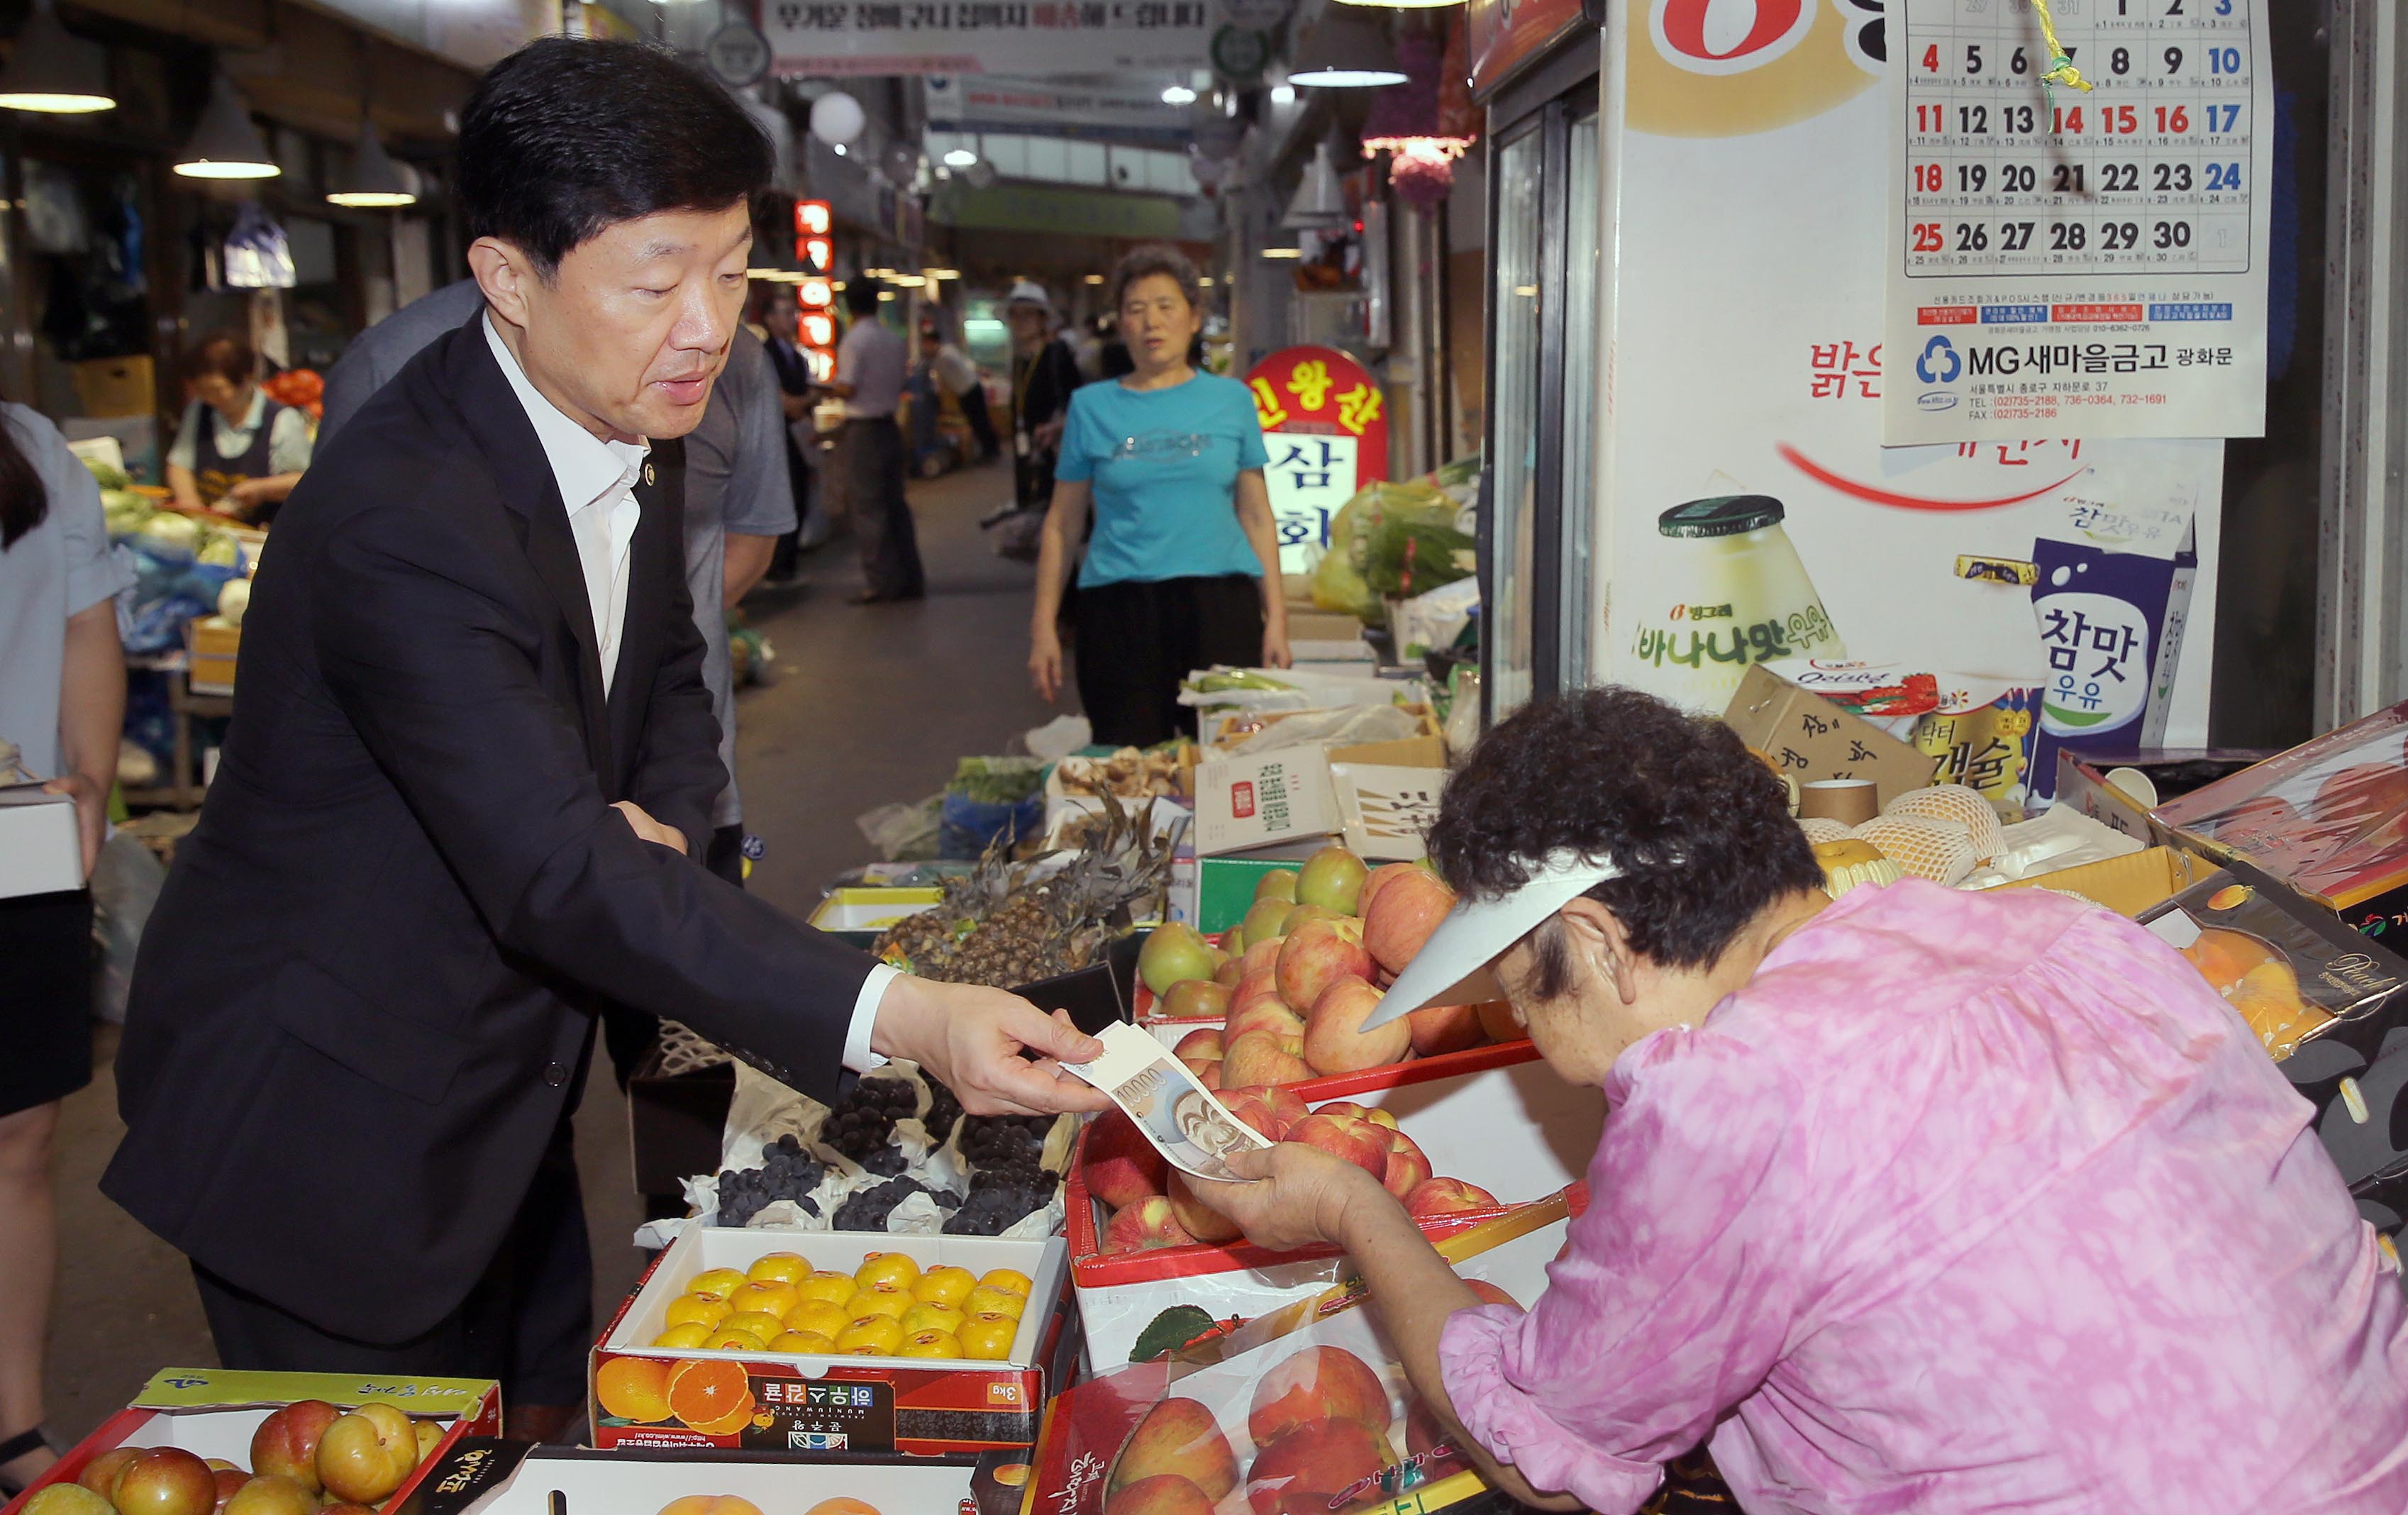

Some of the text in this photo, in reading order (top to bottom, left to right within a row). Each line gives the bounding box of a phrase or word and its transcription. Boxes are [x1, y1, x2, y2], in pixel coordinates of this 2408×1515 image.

[1923, 43, 1938, 73] 4
[1966, 45, 1982, 74] 5
[2011, 47, 2028, 74] 6
[2111, 47, 2130, 74] 8
[2164, 47, 2183, 74] 9
[2208, 47, 2240, 74] 10
[1916, 104, 2241, 134] 11 12 13 14 15 16 17
[1914, 162, 2241, 192] 18 19 20 21 22 23 24
[1912, 223, 1943, 252] 25
[1955, 222, 1987, 252] 26
[2000, 222, 2036, 250] 27
[2050, 222, 2086, 250] 28
[2101, 222, 2139, 250] 29
[2153, 221, 2191, 249] 30
[2176, 347, 2234, 367] 광화문
[1969, 382, 2108, 394] 서울특별시 종로구 자하문로 37
[1970, 398, 1987, 409] TEL
[2120, 394, 2167, 405] 732-1691
[1968, 410, 1987, 421] FAX
[2041, 609, 2138, 683] 참맛
[2053, 675, 2103, 711] 우유
[1923, 720, 1955, 746] 닥터
[2325, 953, 2396, 994] Peach
[764, 1383, 870, 1406] 하우스감귤
[992, 1385, 1017, 1402] 3kg
[775, 1405, 865, 1415] MUNJUWANG
[792, 1419, 842, 1432] 문주왕
